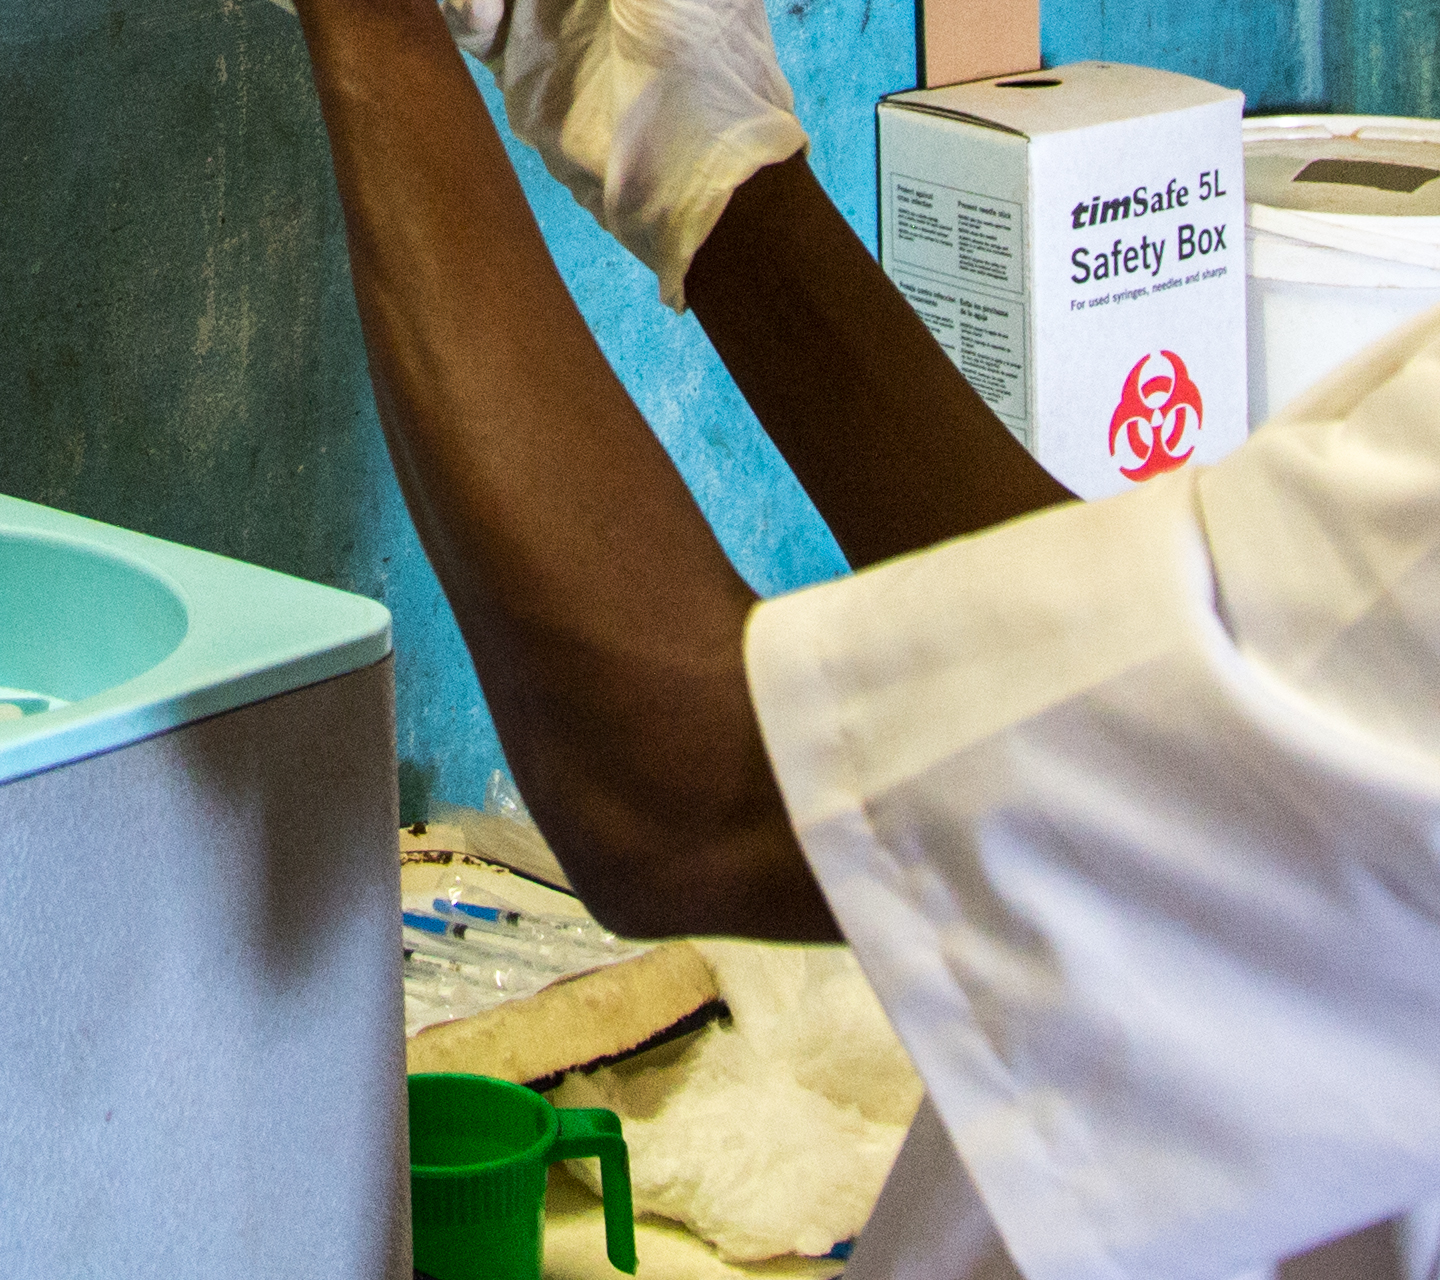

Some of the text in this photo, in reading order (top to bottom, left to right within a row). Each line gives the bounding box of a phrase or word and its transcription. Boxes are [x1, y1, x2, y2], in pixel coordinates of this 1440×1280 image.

[1070, 168, 1227, 230] timSafe 5L
[1070, 223, 1227, 285] Safety Box
[1088, 293, 1110, 309] used
[1112, 286, 1150, 304] syringes,
[1152, 276, 1183, 293] needles
[1185, 270, 1200, 285] and
[1202, 265, 1228, 282] sharps
